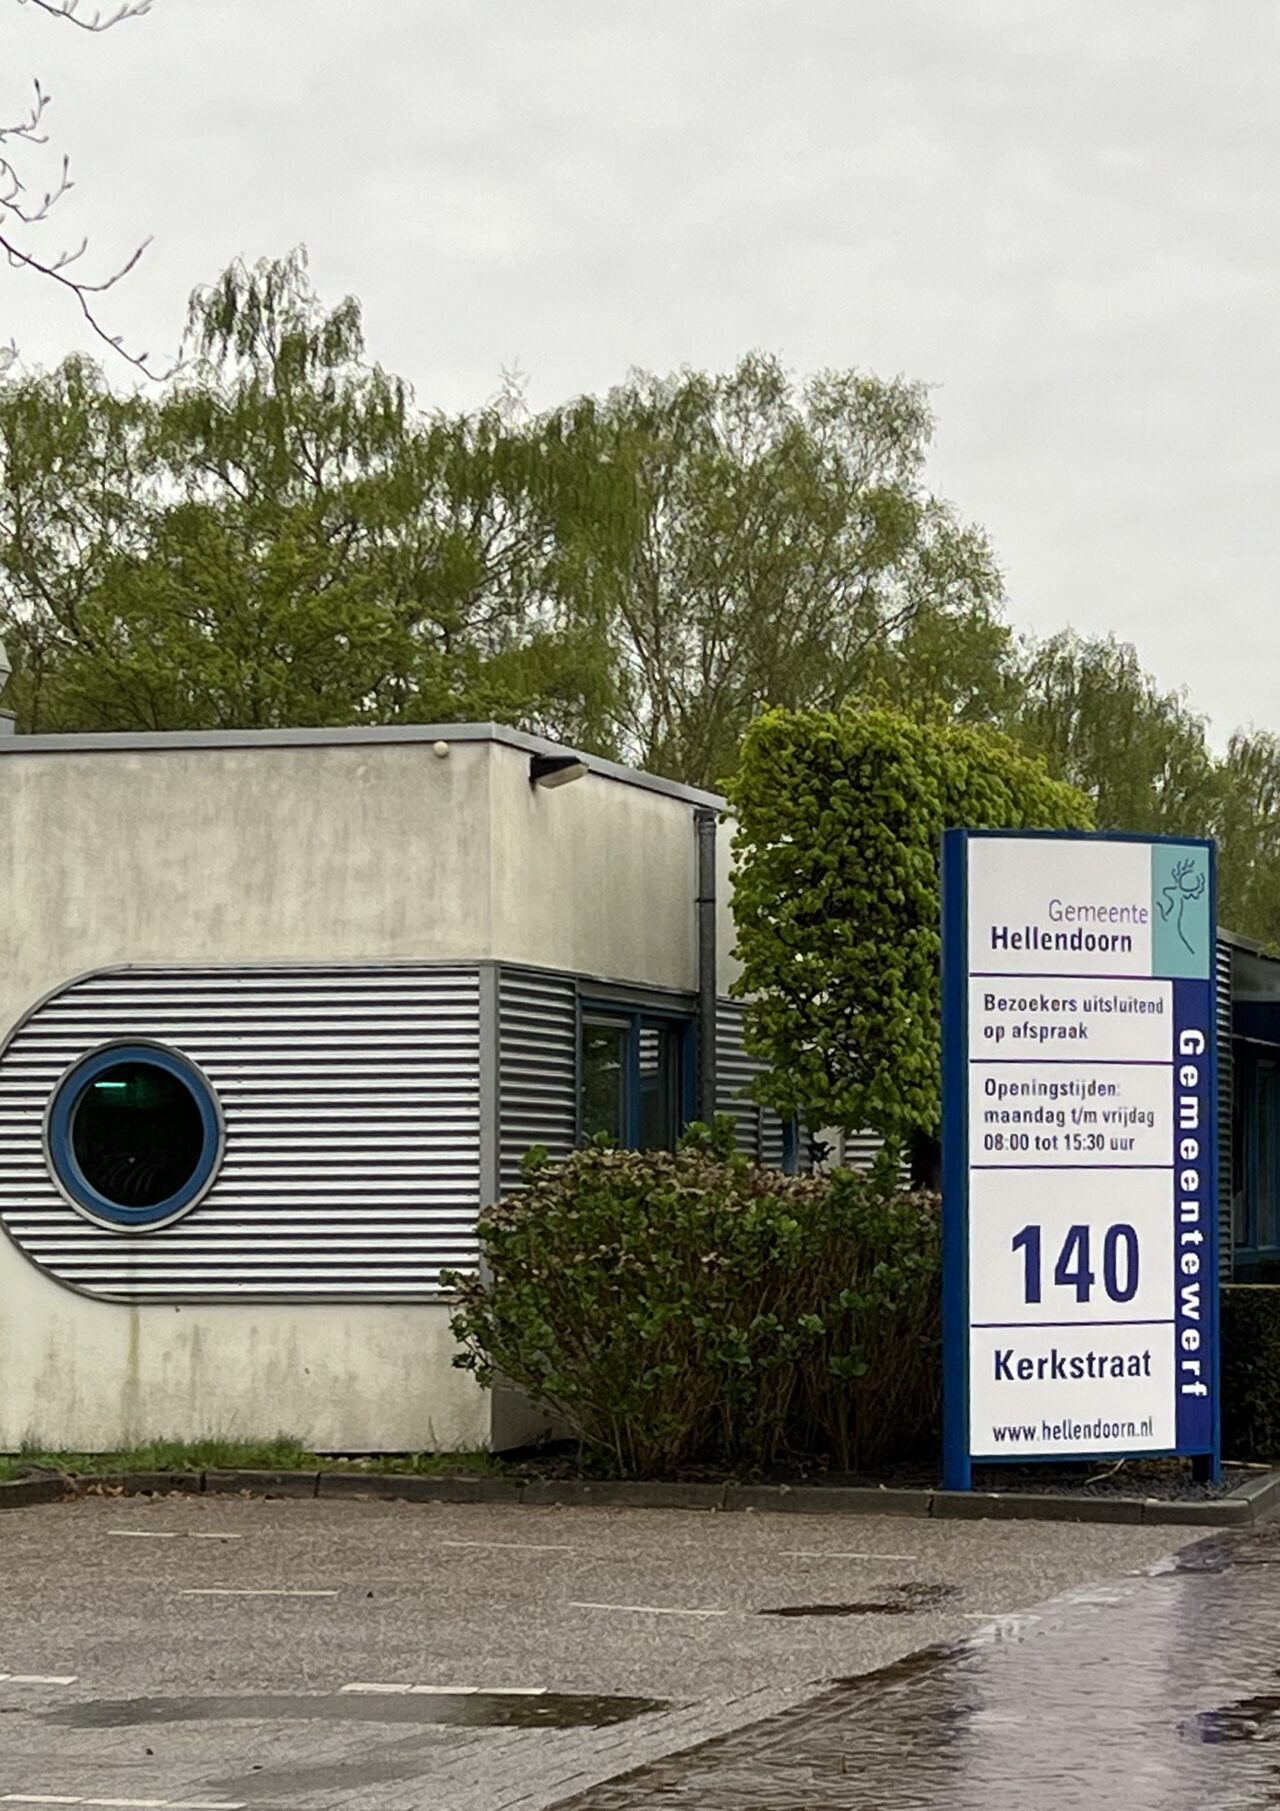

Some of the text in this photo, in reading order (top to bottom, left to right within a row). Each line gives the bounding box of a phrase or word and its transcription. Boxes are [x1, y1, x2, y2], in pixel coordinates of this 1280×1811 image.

[1048, 899, 1149, 924] Gemeente
[991, 926, 1132, 952] Hellendoorn
[983, 993, 1164, 1015] Bezoekers uitsluitend
[983, 1021, 1088, 1043] op afspraak
[983, 1107, 1155, 1128] maandag t/m vrijdag
[983, 1134, 1135, 1152] 08:00 tot 15:30 uur
[1179, 1029, 1207, 1397] Gemeentewerf
[1011, 1223, 1140, 1305] 140
[994, 1349, 1151, 1381] Kerkstraat
[992, 1416, 1154, 1442] www.hellendoorn.nl
